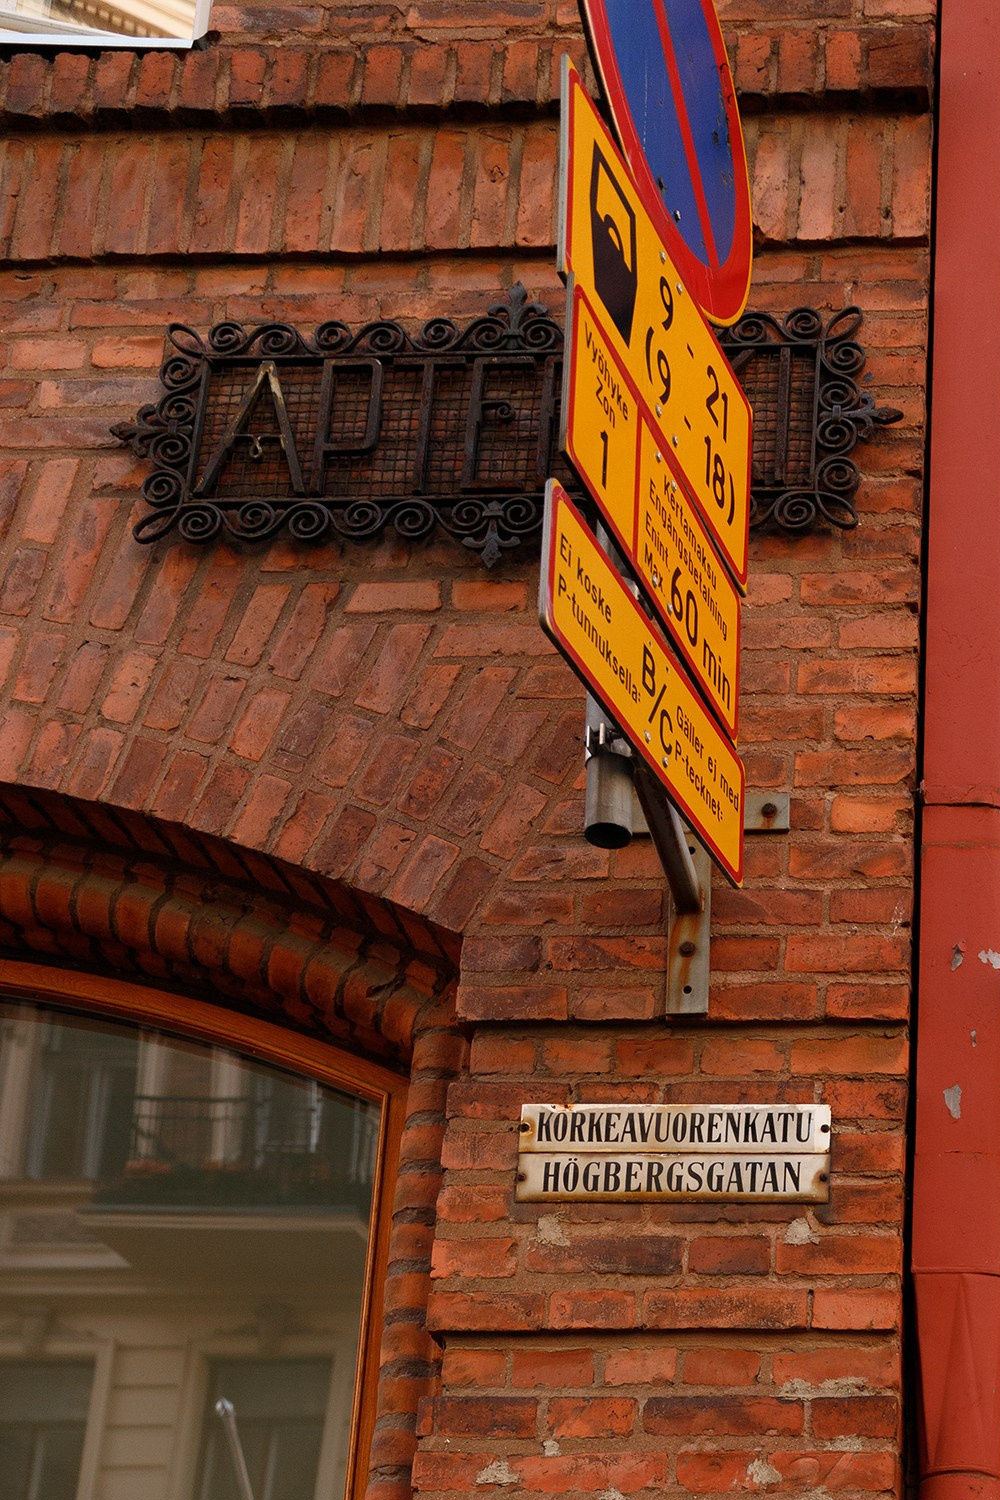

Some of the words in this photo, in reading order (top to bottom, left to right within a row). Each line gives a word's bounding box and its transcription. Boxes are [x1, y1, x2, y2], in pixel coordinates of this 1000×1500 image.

[585, 321, 629, 420] Vyöhyke
[595, 375, 616, 428] Zon
[660, 276, 673, 331] 9
[705, 365, 729, 443] 21
[600, 430, 609, 490] 1
[645, 326, 672, 405] (9
[704, 435, 735, 526] 18)
[560, 532, 572, 568] Ei
[577, 557, 612, 624] koske
[645, 510, 671, 573] Enint.
[649, 478, 728, 641] Engångsbetalning
[558, 573, 641, 704] P-tunnuksella:
[644, 542, 666, 597] Max.
[671, 566, 698, 647] 60
[703, 638, 731, 711] min
[642, 644, 673, 756] B/C
[674, 740, 724, 822] P-tecknet:
[676, 705, 705, 760] Gäller
[708, 755, 717, 780] ej
[720, 774, 739, 813] med
[537, 1111, 813, 1143] KORKEAVUORENKATU
[542, 1157, 802, 1193] HÖGBERGSGATAN
